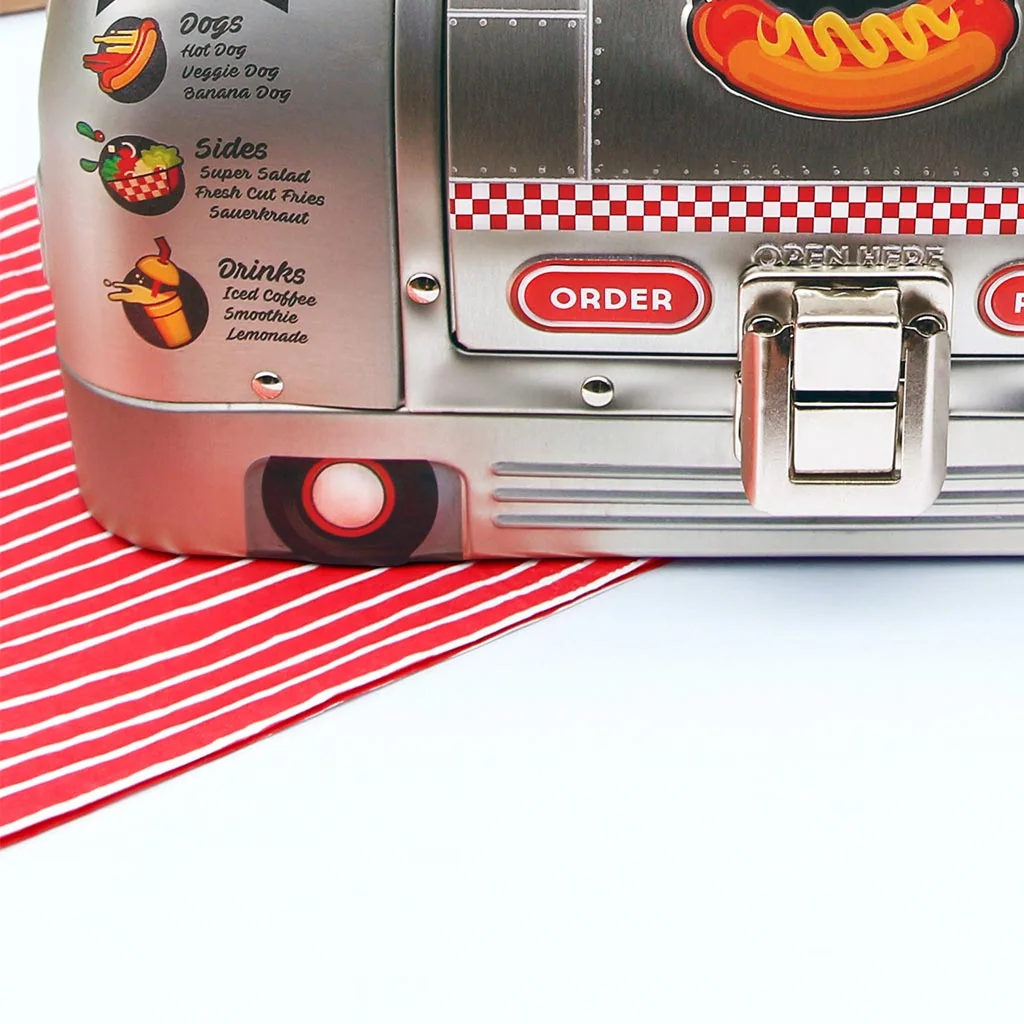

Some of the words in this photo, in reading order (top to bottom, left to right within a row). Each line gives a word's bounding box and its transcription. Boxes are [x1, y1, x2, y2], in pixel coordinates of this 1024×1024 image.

[180, 12, 243, 39] Dogs
[180, 43, 210, 58] Hot
[214, 43, 247, 59] Dog
[182, 64, 240, 81] Veggie
[244, 64, 280, 81] Dog
[183, 86, 251, 100] Banana
[256, 86, 291, 103] Dog
[195, 137, 268, 160] Sides
[200, 166, 252, 182] Super
[257, 167, 311, 183] Salad
[194, 185, 242, 200] Fresh
[247, 187, 277, 202] Cut
[281, 188, 325, 206] Fries
[209, 205, 309, 225] Sauerkraut
[751, 242, 849, 268] OPEN
[857, 243, 945, 268] HERE
[218, 257, 306, 284] Drinks
[223, 286, 260, 301] Iced
[263, 288, 317, 306] Coffee
[550, 286, 673, 311] ORDER
[223, 307, 299, 324] Smoothie
[226, 327, 308, 344] Lemonade
